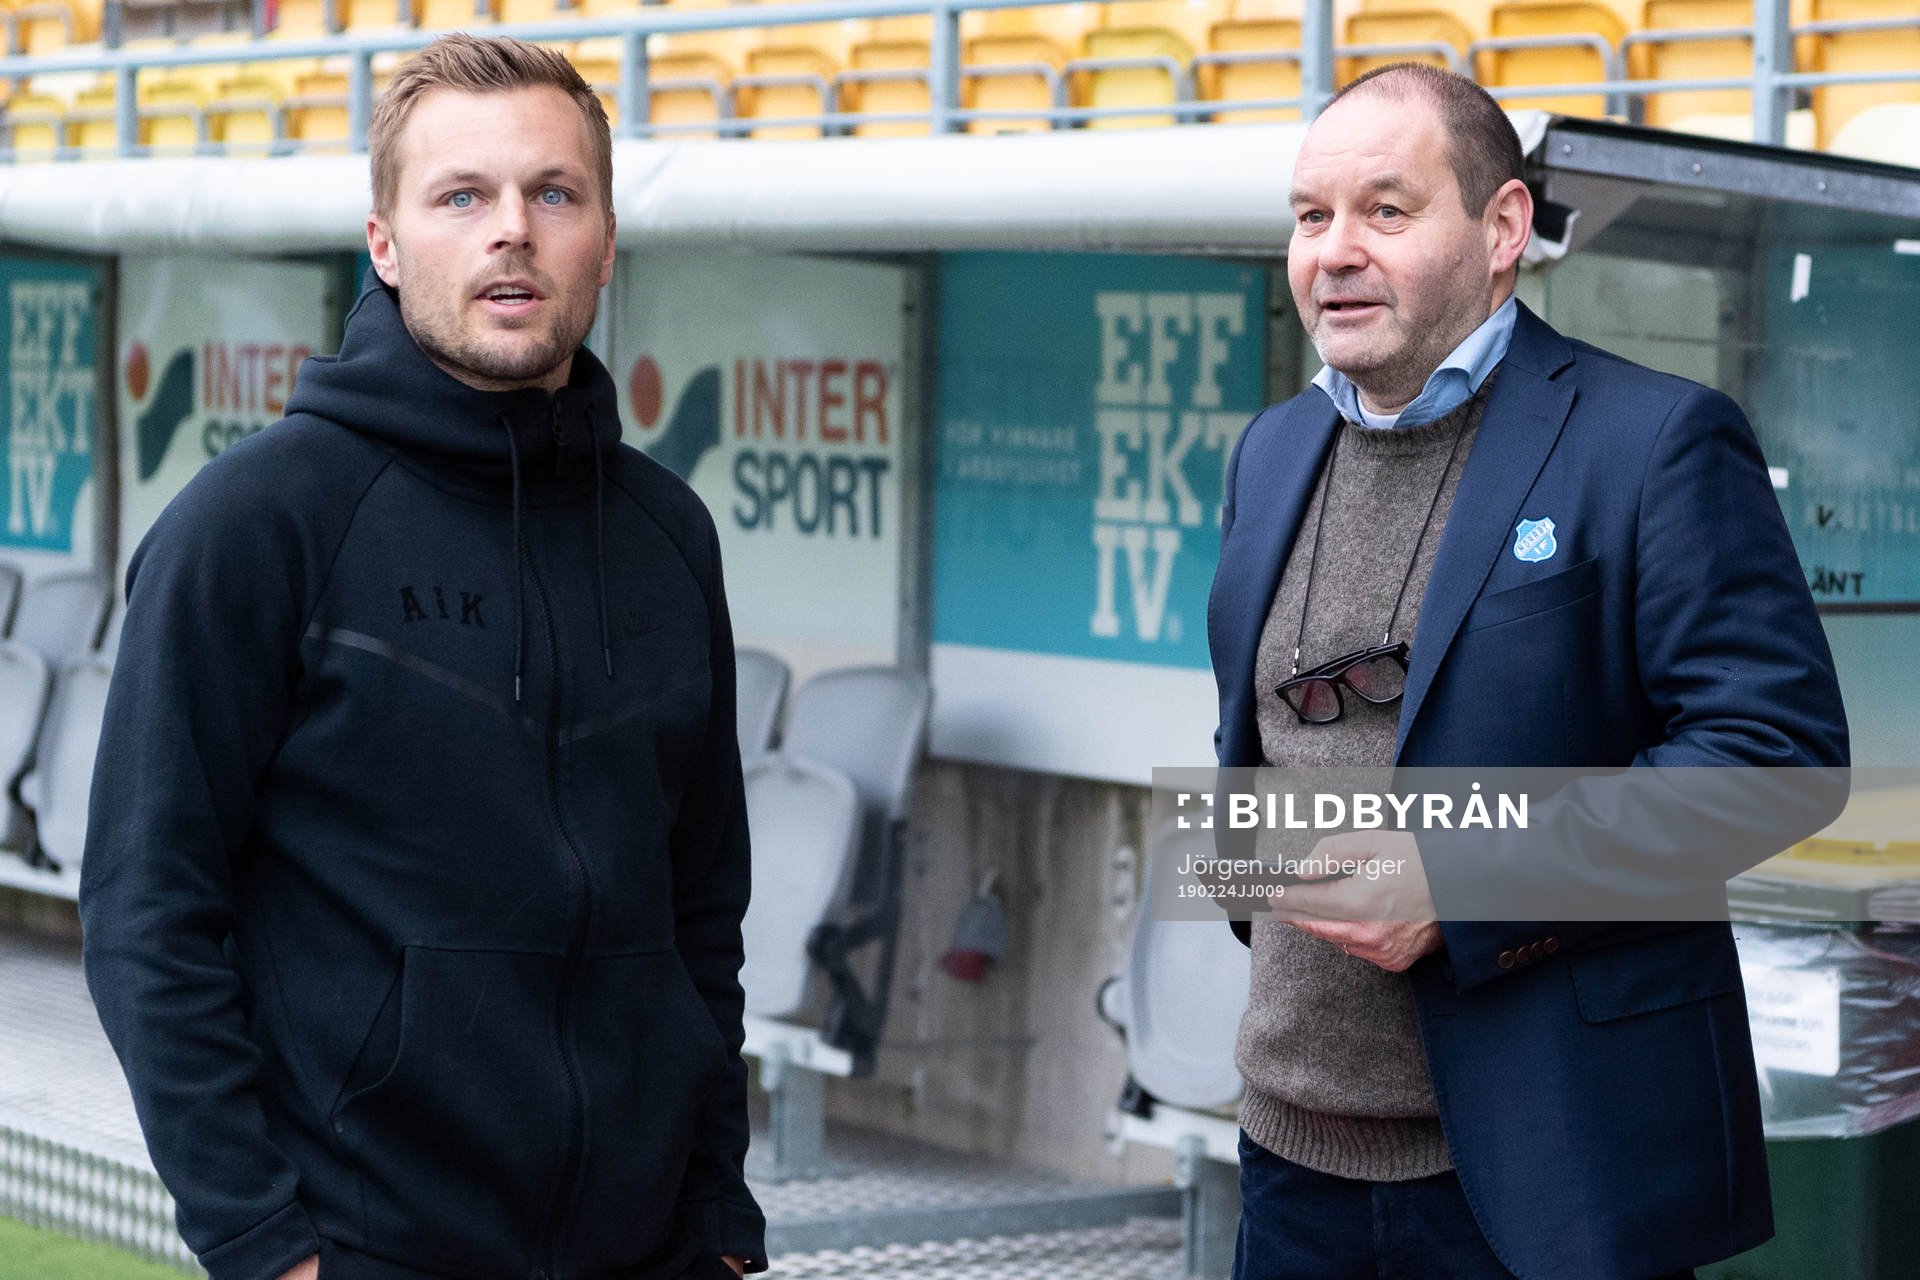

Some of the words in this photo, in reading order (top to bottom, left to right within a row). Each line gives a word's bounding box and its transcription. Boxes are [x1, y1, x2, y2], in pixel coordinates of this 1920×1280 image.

[1095, 292, 1246, 408] EFF
[734, 358, 890, 445] INTER
[732, 450, 890, 538] SPORT
